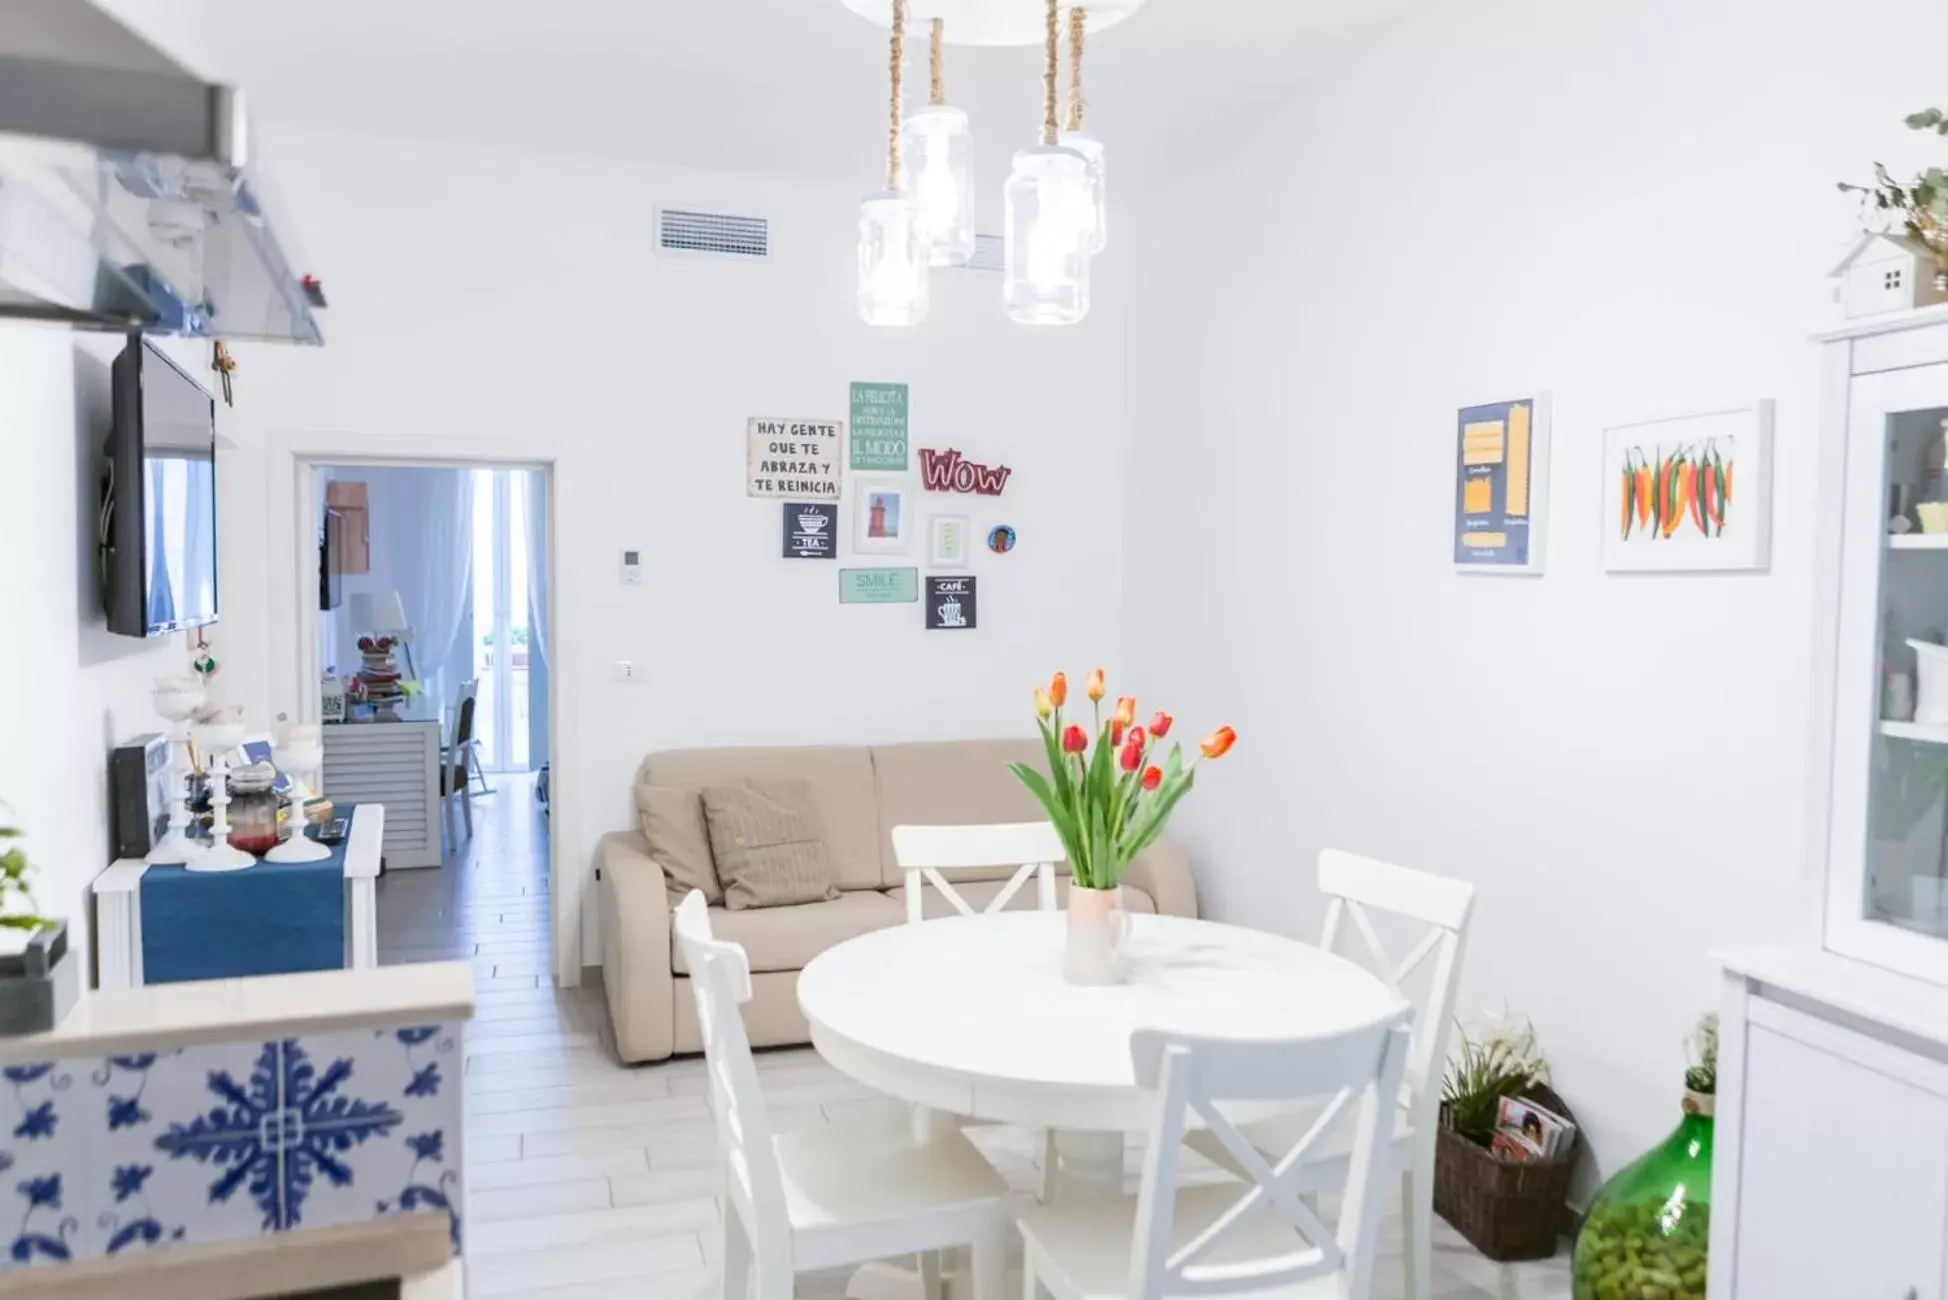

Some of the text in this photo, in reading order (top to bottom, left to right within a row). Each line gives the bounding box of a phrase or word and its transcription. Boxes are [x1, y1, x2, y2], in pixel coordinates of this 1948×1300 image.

[757, 422, 836, 437] HAY GENTE
[769, 442, 820, 455] QUE TE
[866, 440, 905, 456] MODO
[760, 460, 831, 474] ABRAZA Y
[755, 479, 836, 494] TE REINICIA
[802, 538, 820, 548] TEA
[856, 573, 900, 587] SMILE
